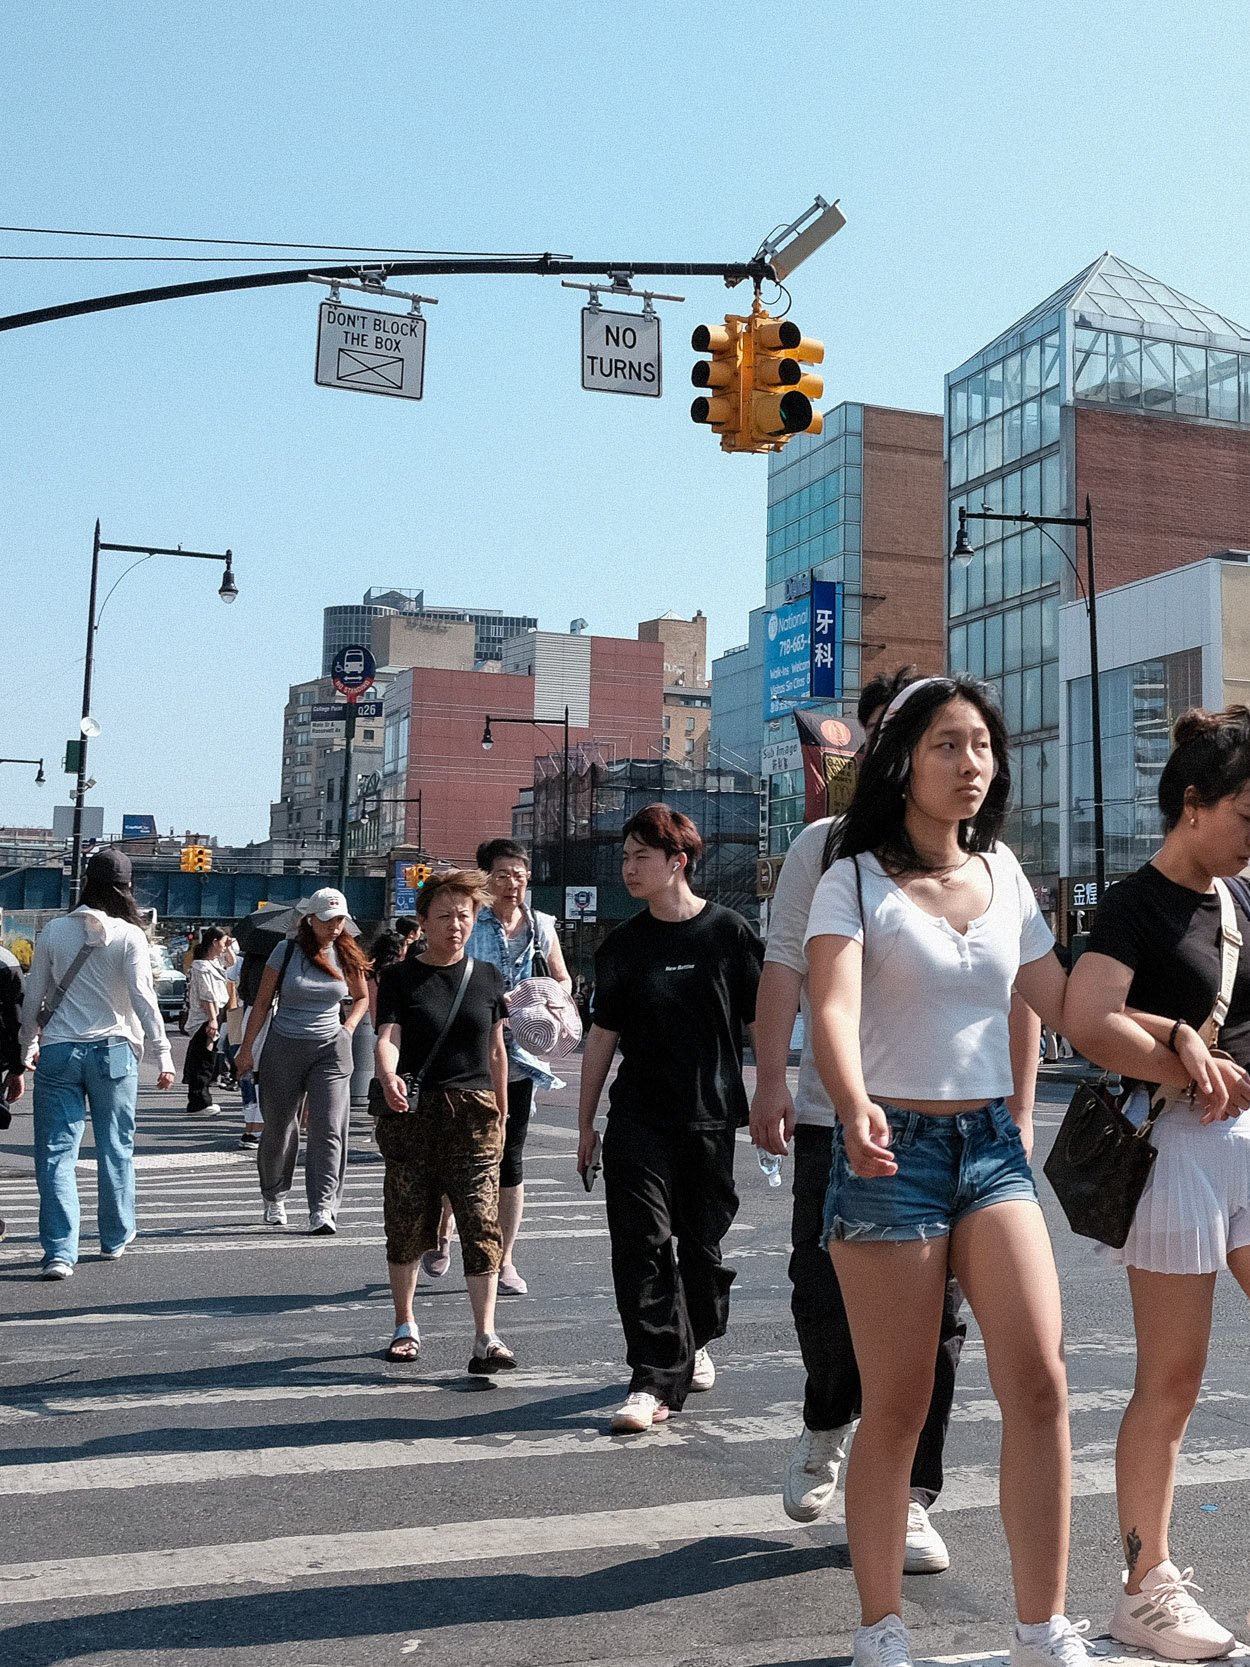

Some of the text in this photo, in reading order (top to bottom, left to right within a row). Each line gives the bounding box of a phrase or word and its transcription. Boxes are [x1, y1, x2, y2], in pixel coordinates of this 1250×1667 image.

[327, 311, 418, 338] DON'T BLOCK
[605, 324, 637, 349] NO
[343, 331, 401, 353] THE BOX
[586, 355, 656, 383] TURNS
[779, 608, 809, 633] National
[814, 609, 834, 669] 牙科
[358, 704, 376, 716] Q26
